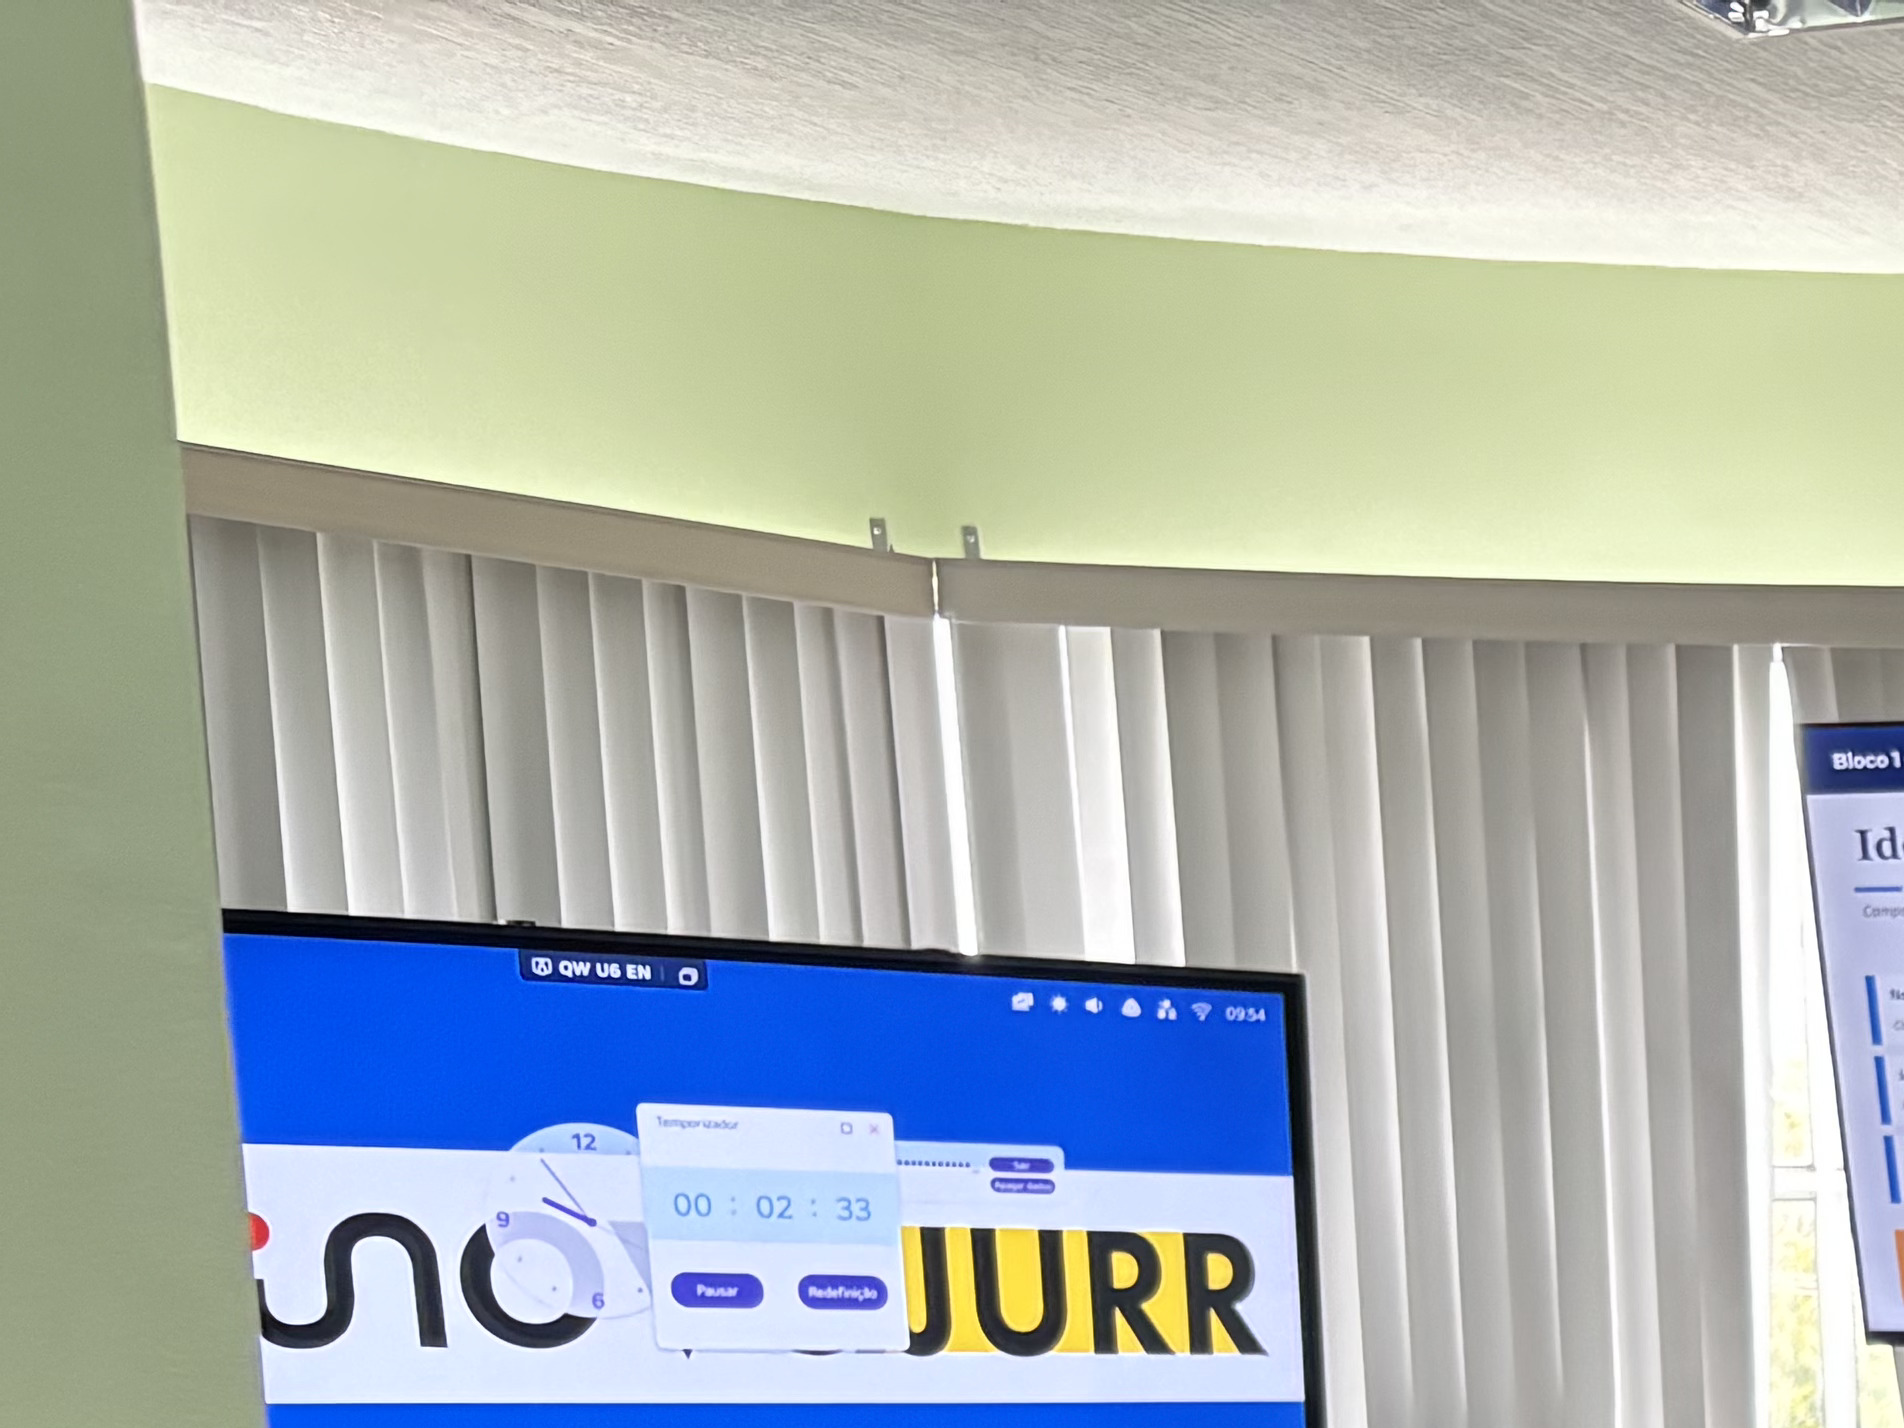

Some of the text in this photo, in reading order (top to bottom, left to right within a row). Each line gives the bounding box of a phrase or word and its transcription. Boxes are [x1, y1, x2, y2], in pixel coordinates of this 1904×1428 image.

[1832, 751, 1886, 770] Bloco
[1890, 750, 1901, 769] 1
[559, 960, 591, 978] QW
[626, 964, 651, 980] EN
[656, 1115, 738, 1131] Temporizador
[572, 1133, 598, 1152] 12
[673, 1193, 712, 1217] 00
[756, 1195, 793, 1220] 02
[836, 1197, 872, 1222] 33
[496, 1211, 510, 1229] 9
[697, 1284, 738, 1299] Pausar
[808, 1285, 878, 1303] Redefinição
[592, 1292, 605, 1310] 6
